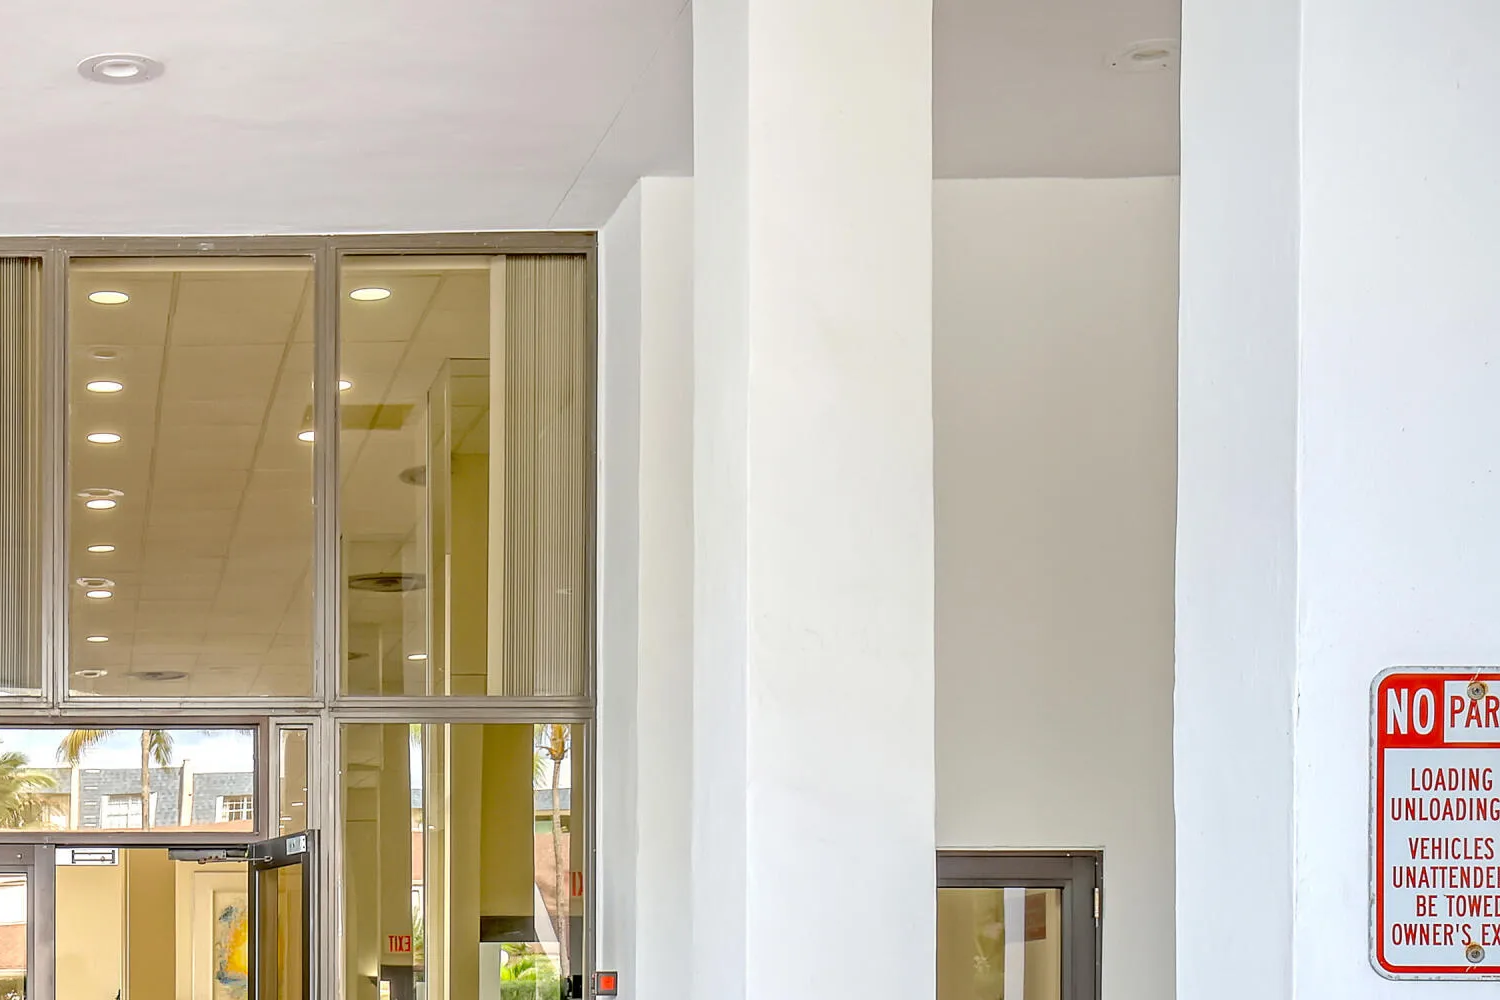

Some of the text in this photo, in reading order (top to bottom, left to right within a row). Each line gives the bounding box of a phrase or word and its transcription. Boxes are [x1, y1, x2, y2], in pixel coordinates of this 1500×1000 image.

[1386, 687, 1500, 735] NO PAR
[1411, 767, 1493, 791] LOADING
[1391, 797, 1500, 821] UNLOADING
[1408, 837, 1494, 860] VEHICLES
[1393, 866, 1500, 889] UNATTENDE
[1416, 894, 1438, 917] BE
[1392, 923, 1472, 946] OWNER'S
